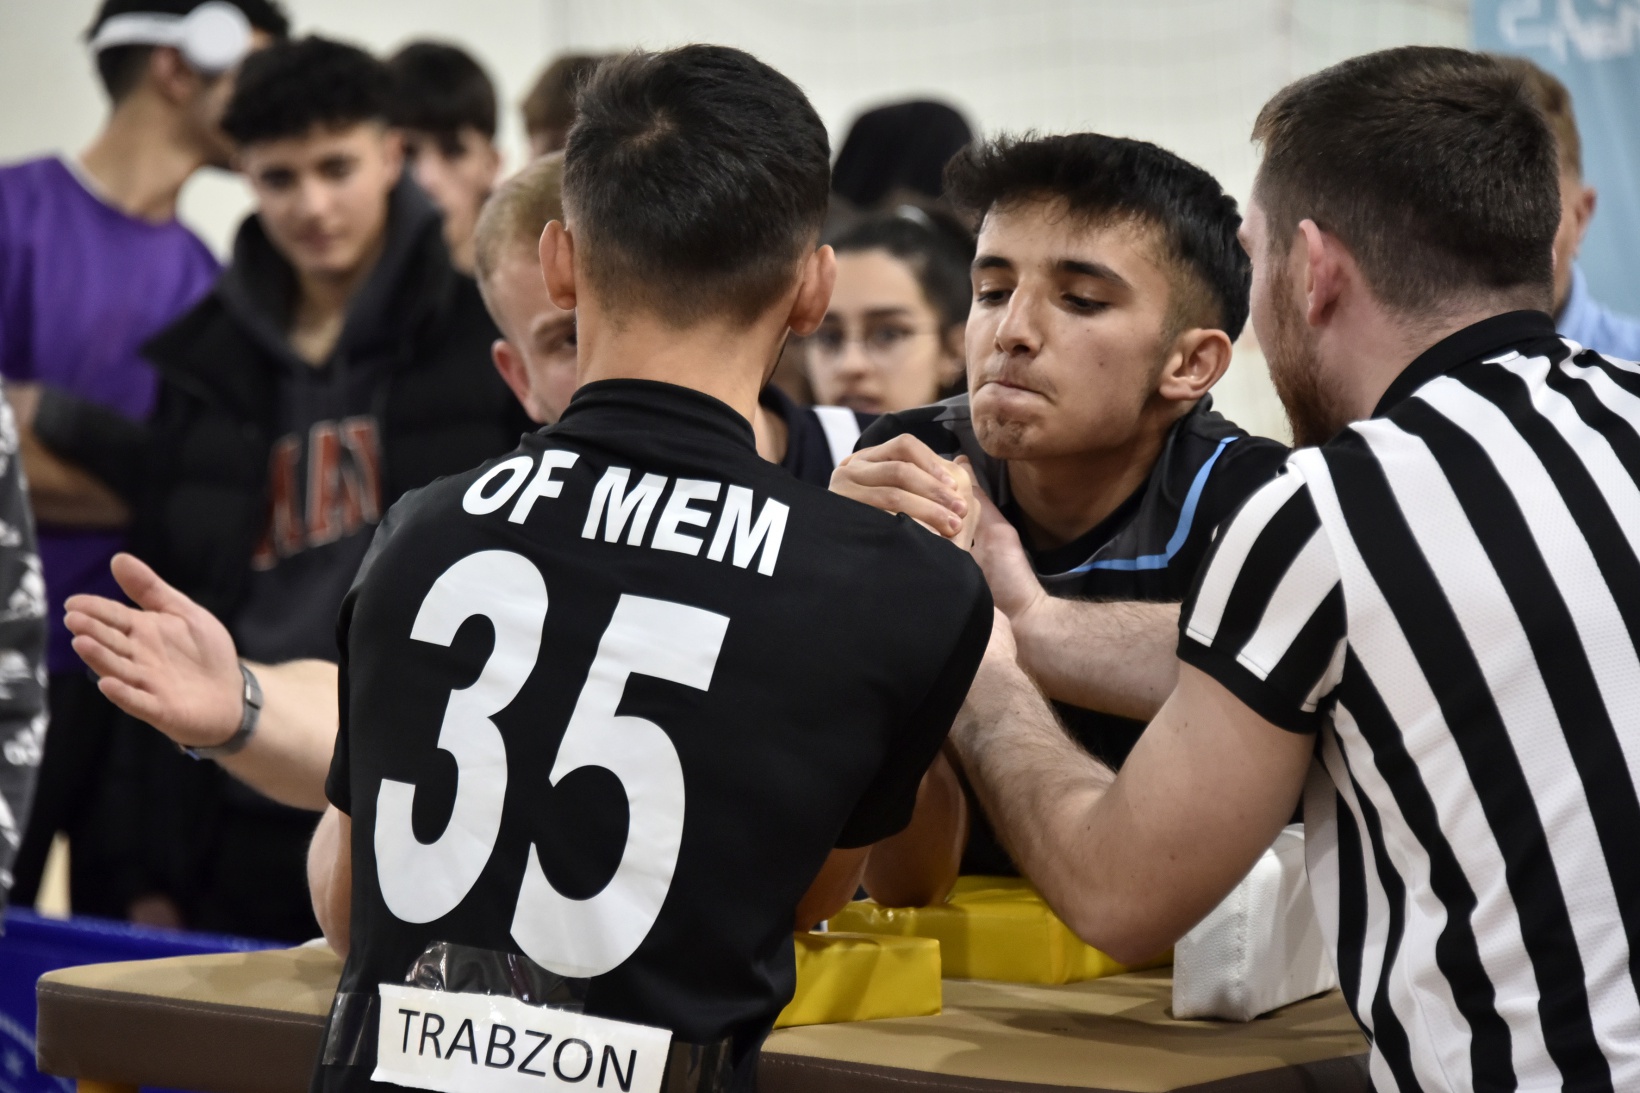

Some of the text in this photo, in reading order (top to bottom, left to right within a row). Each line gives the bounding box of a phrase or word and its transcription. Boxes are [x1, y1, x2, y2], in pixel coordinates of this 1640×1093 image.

[462, 450, 580, 525] OF
[581, 465, 790, 577] MEM
[374, 549, 731, 978] 35
[398, 1008, 637, 1093] TRABZON
